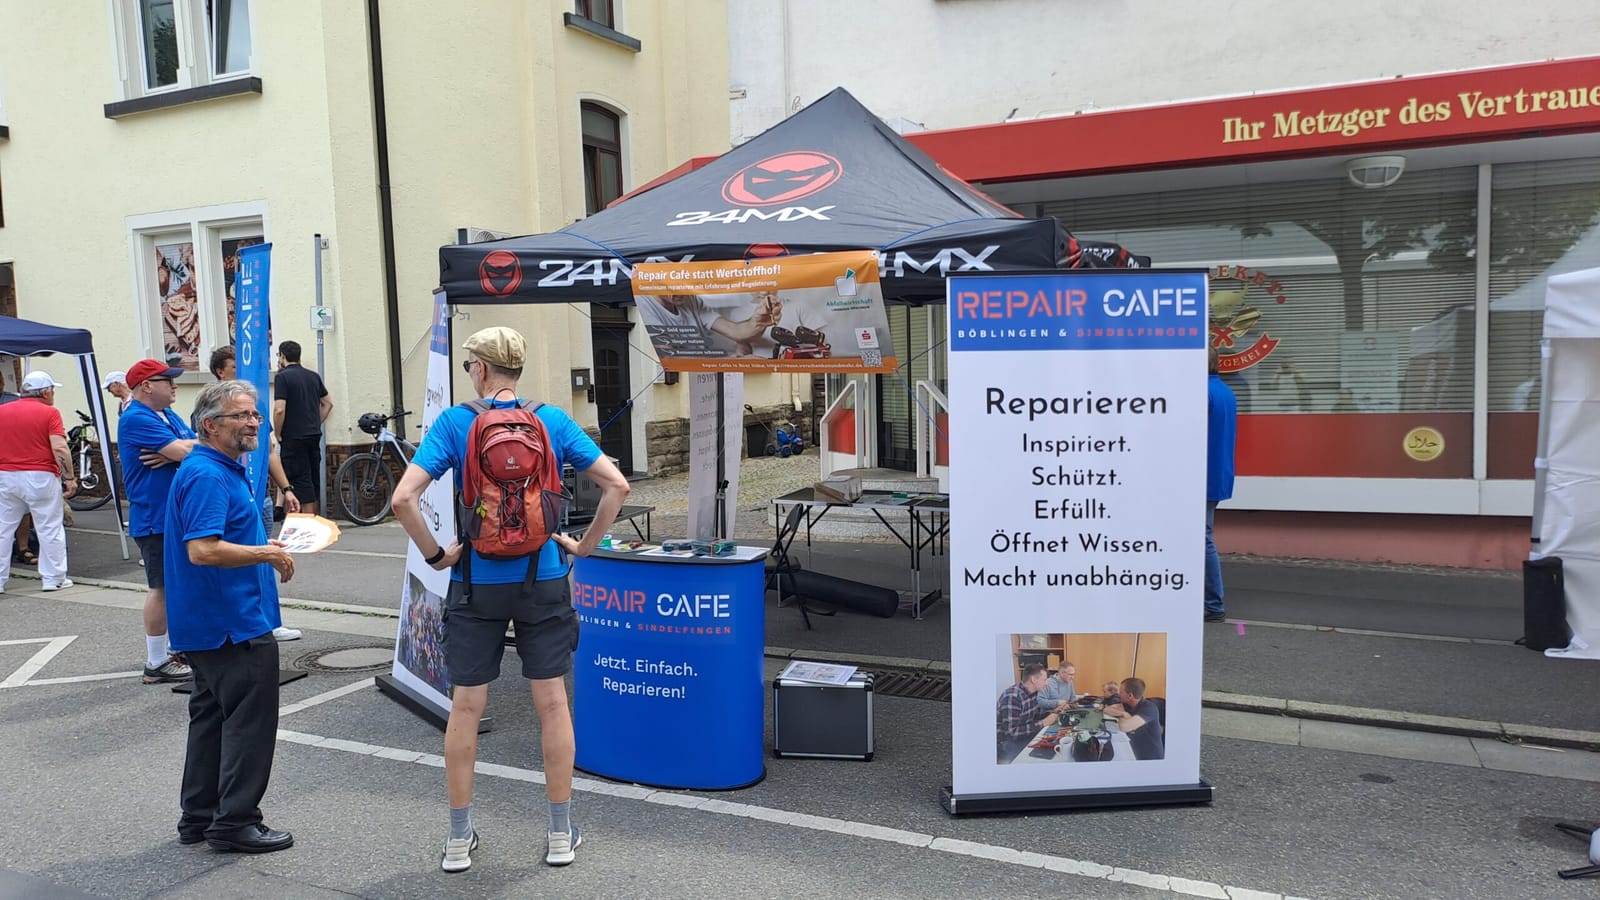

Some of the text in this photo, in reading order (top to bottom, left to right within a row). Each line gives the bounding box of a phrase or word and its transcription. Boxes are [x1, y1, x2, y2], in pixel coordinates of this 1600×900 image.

[1222, 118, 1265, 143] Ihr
[1272, 106, 1391, 138] Metzger
[1398, 98, 1451, 126] des
[666, 205, 837, 227] 24MX
[638, 264, 781, 283] Repair Café statt Wertstoffhof!
[241, 261, 253, 367] CAFE
[957, 287, 1198, 319] REPAIR CAFE
[958, 327, 1199, 338] BÖBLINGEN & SINDELFINGEN
[1218, 349, 1261, 368] ZGEREI
[986, 387, 1167, 421] Reparieren
[1023, 433, 1131, 457] Inspiriert.
[1032, 466, 1122, 486] Schützt.
[1035, 499, 1111, 519] Erfüllt.
[990, 530, 1163, 553] Öffnet Wissen.
[964, 565, 1189, 590] Macht unabhängig.
[657, 593, 730, 618] CAFE
[580, 615, 731, 634] BLINGEN & SINDELFINGEN
[594, 654, 698, 677] Jetzt. Einfach.
[603, 677, 685, 699] Reparieren!
